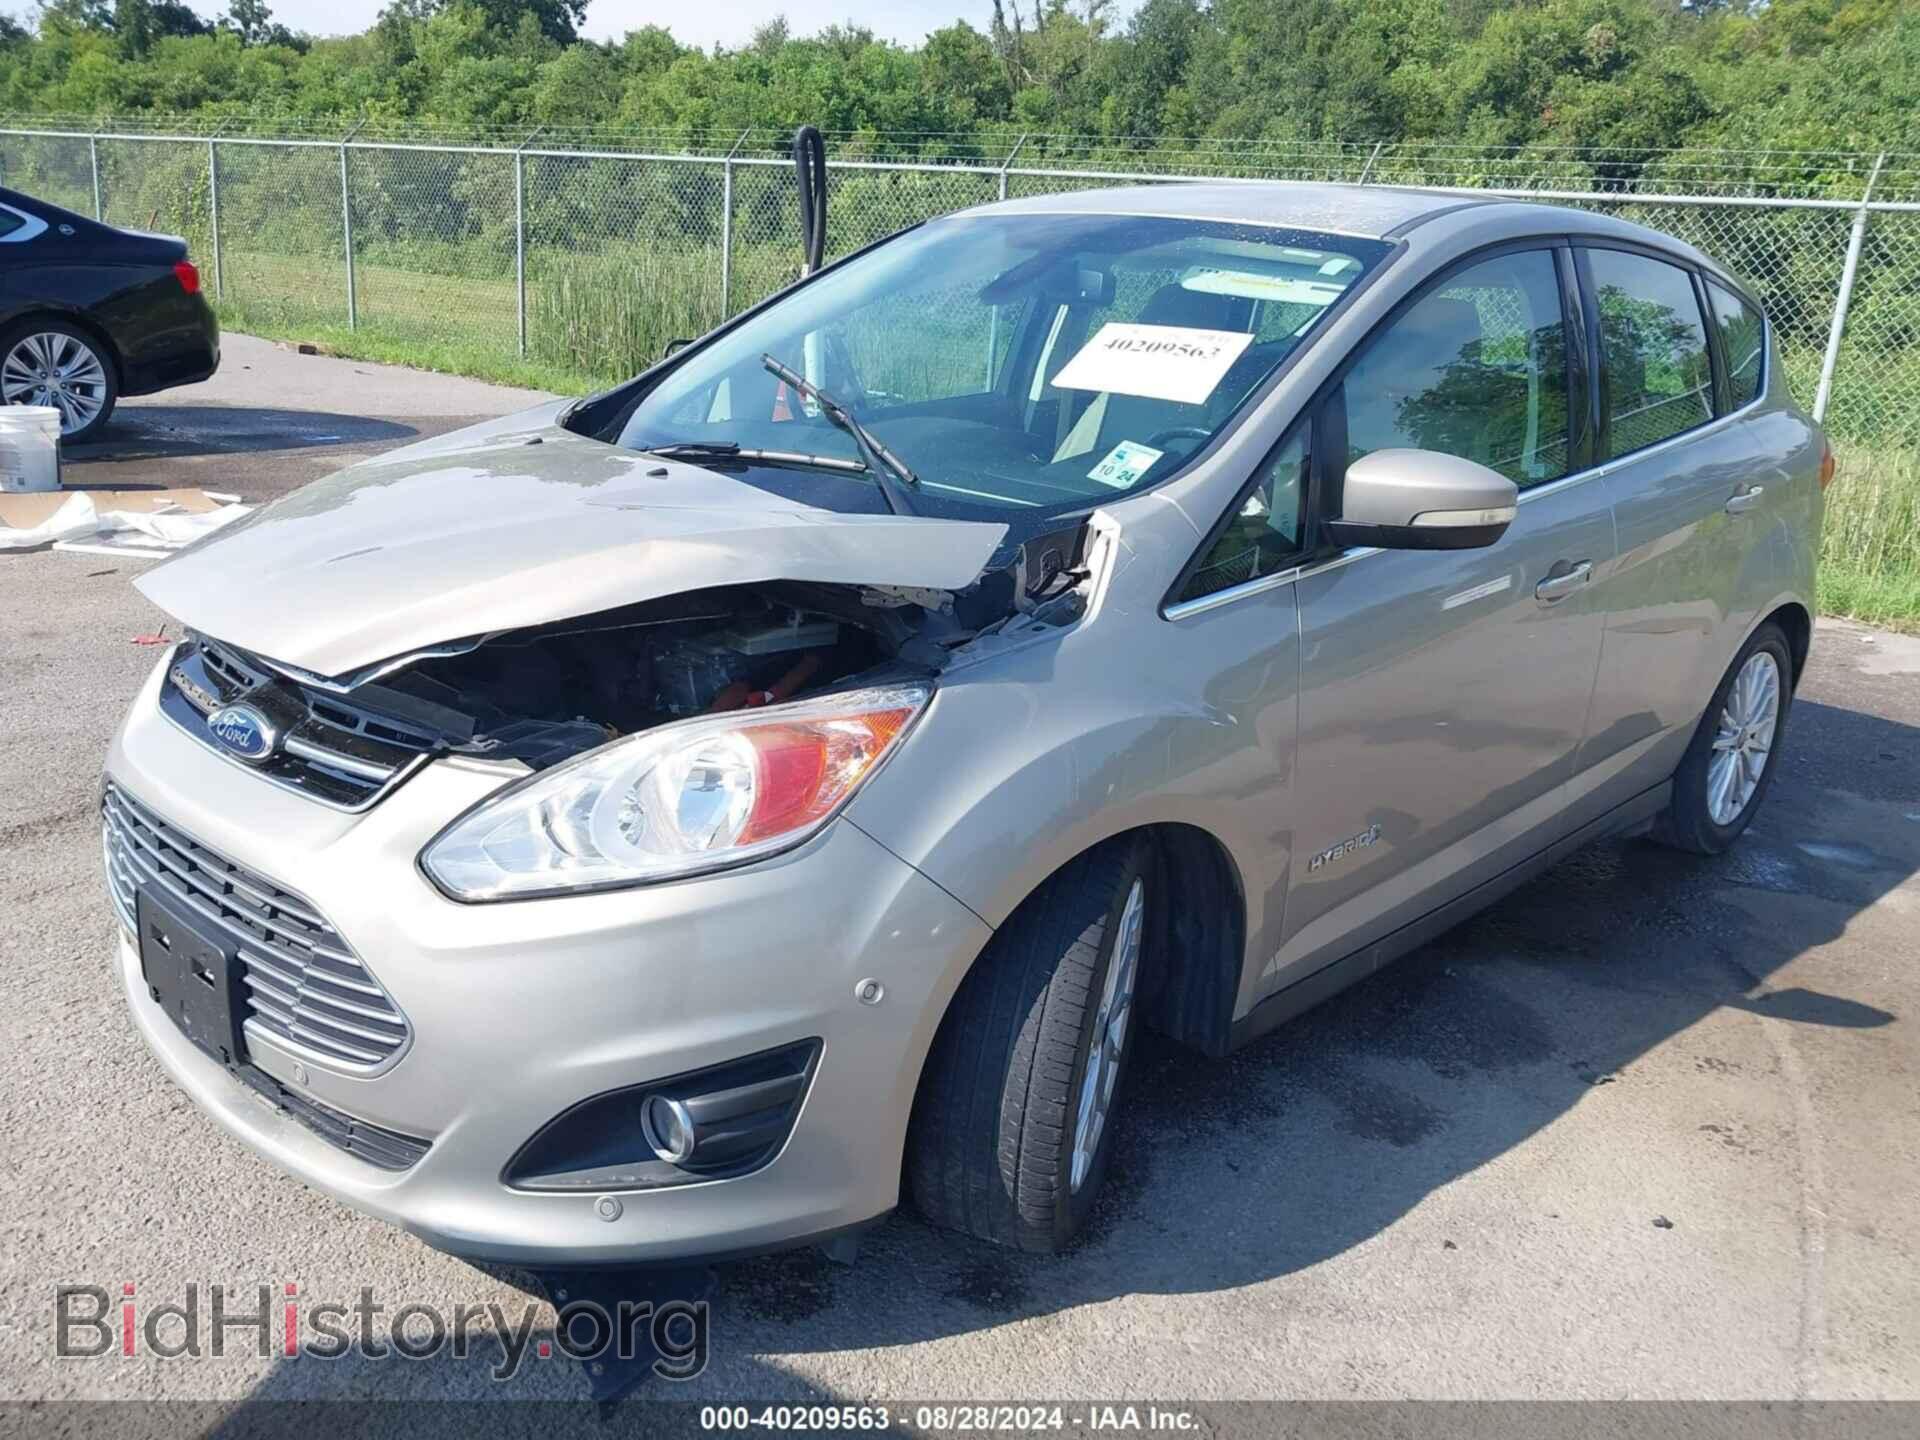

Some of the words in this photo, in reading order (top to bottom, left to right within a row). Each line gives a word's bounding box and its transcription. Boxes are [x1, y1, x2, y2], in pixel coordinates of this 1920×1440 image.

[1099, 464, 1115, 476] 10
[1116, 470, 1135, 483] 24
[216, 711, 254, 748] Ford
[1308, 832, 1372, 873] HYBRID
